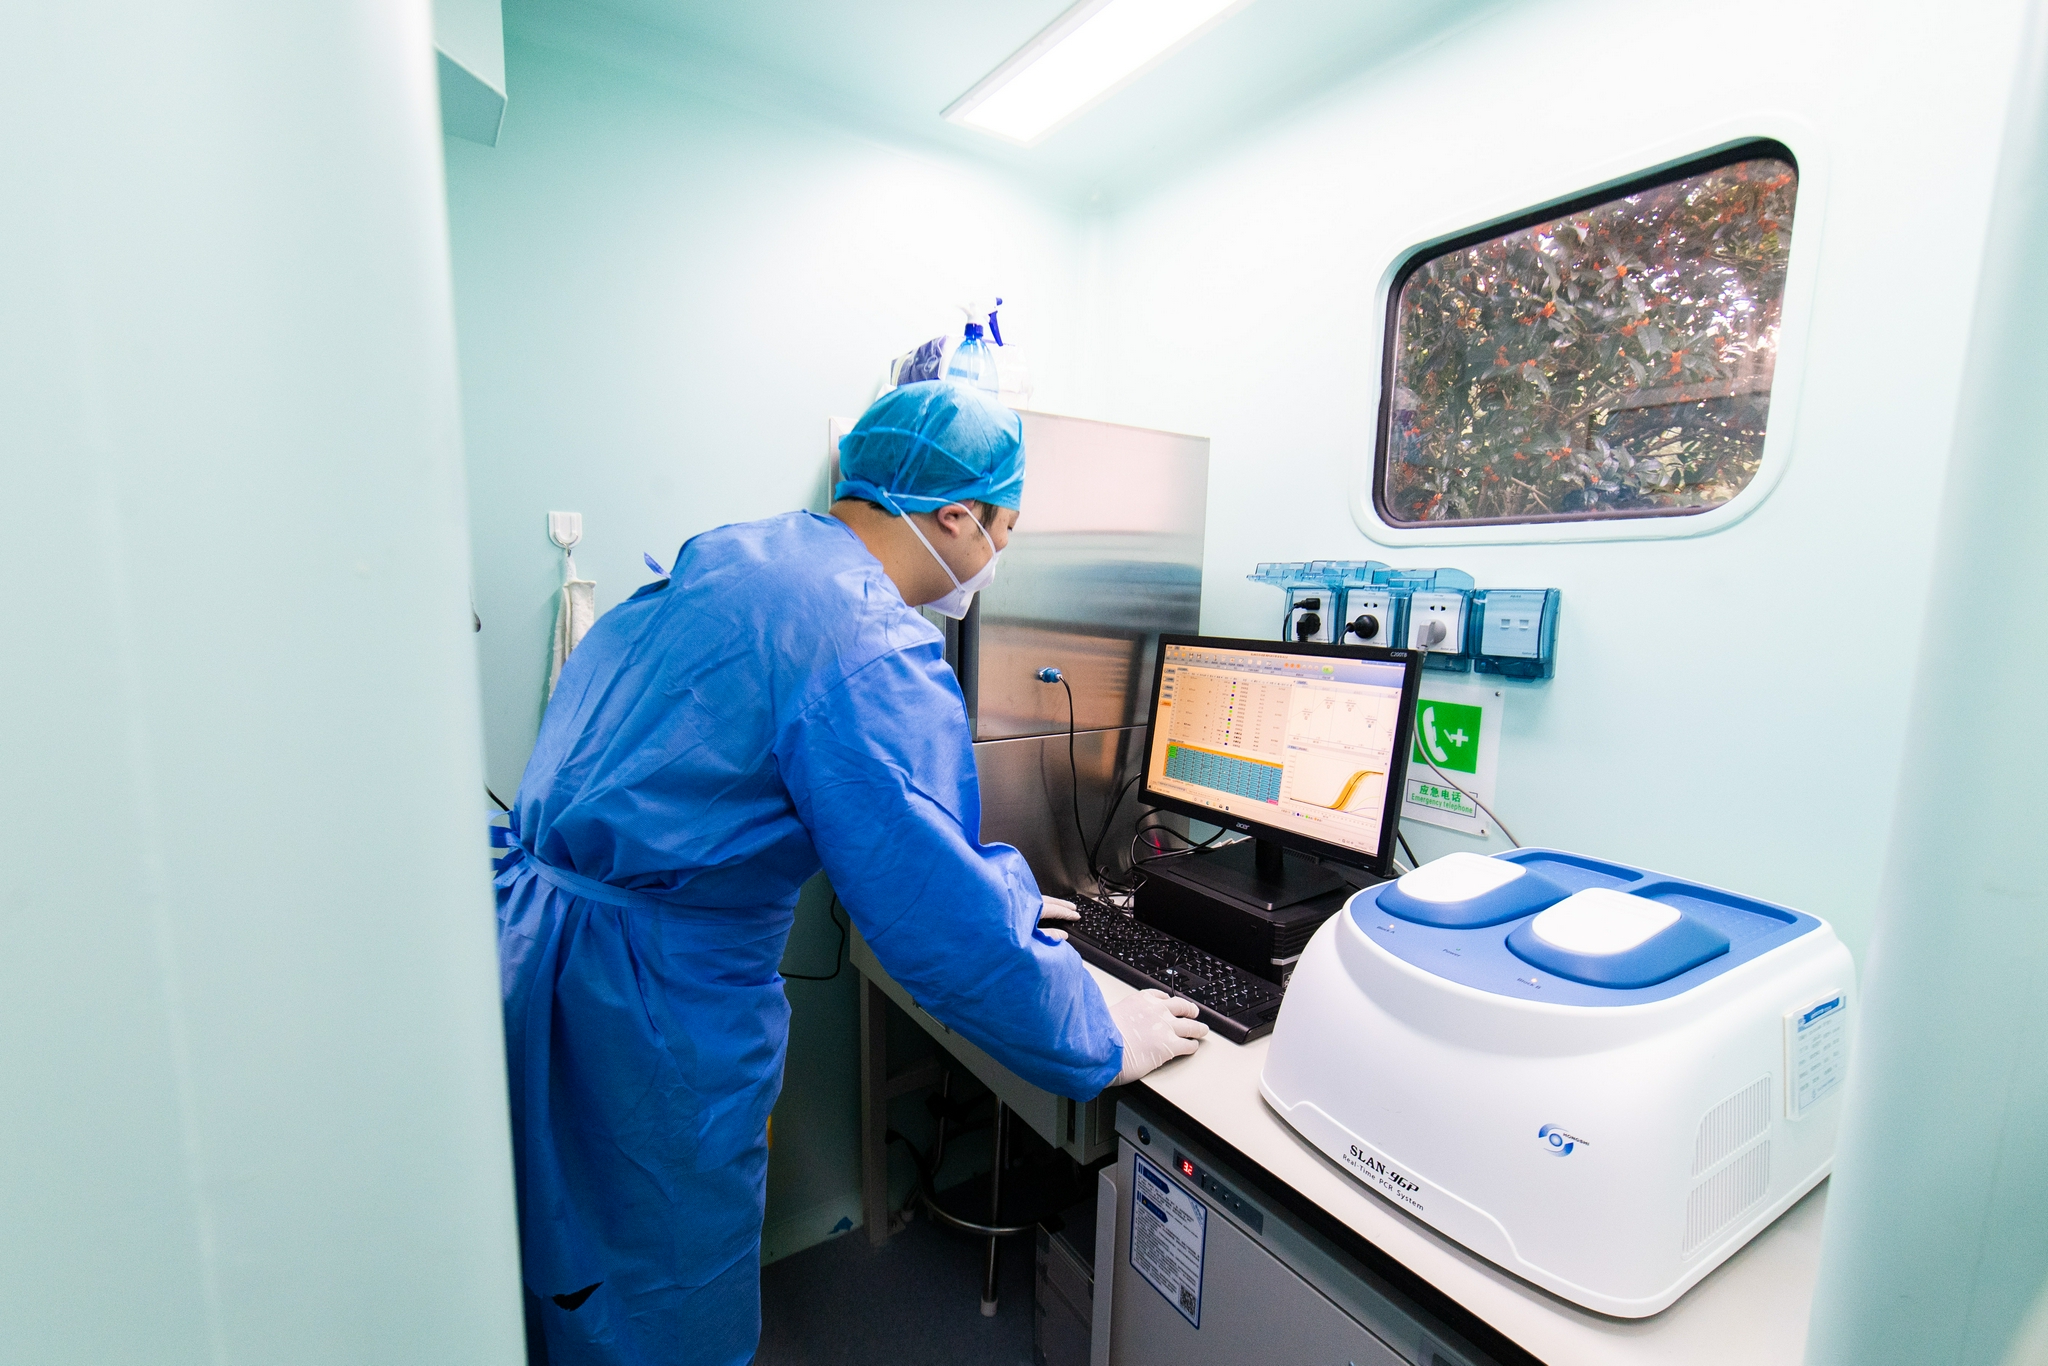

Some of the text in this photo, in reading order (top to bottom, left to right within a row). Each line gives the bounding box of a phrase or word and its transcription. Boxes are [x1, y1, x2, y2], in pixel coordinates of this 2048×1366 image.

[1419, 785, 1461, 803] 应急电话
[1411, 793, 1473, 814] Emergency telephone
[1235, 821, 1251, 830] acer
[1442, 948, 1461, 956] Power
[1516, 977, 1534, 986] Block
[1349, 1144, 1420, 1193] SLAN-96P
[1342, 1153, 1424, 1212] Real-Time PCR System
